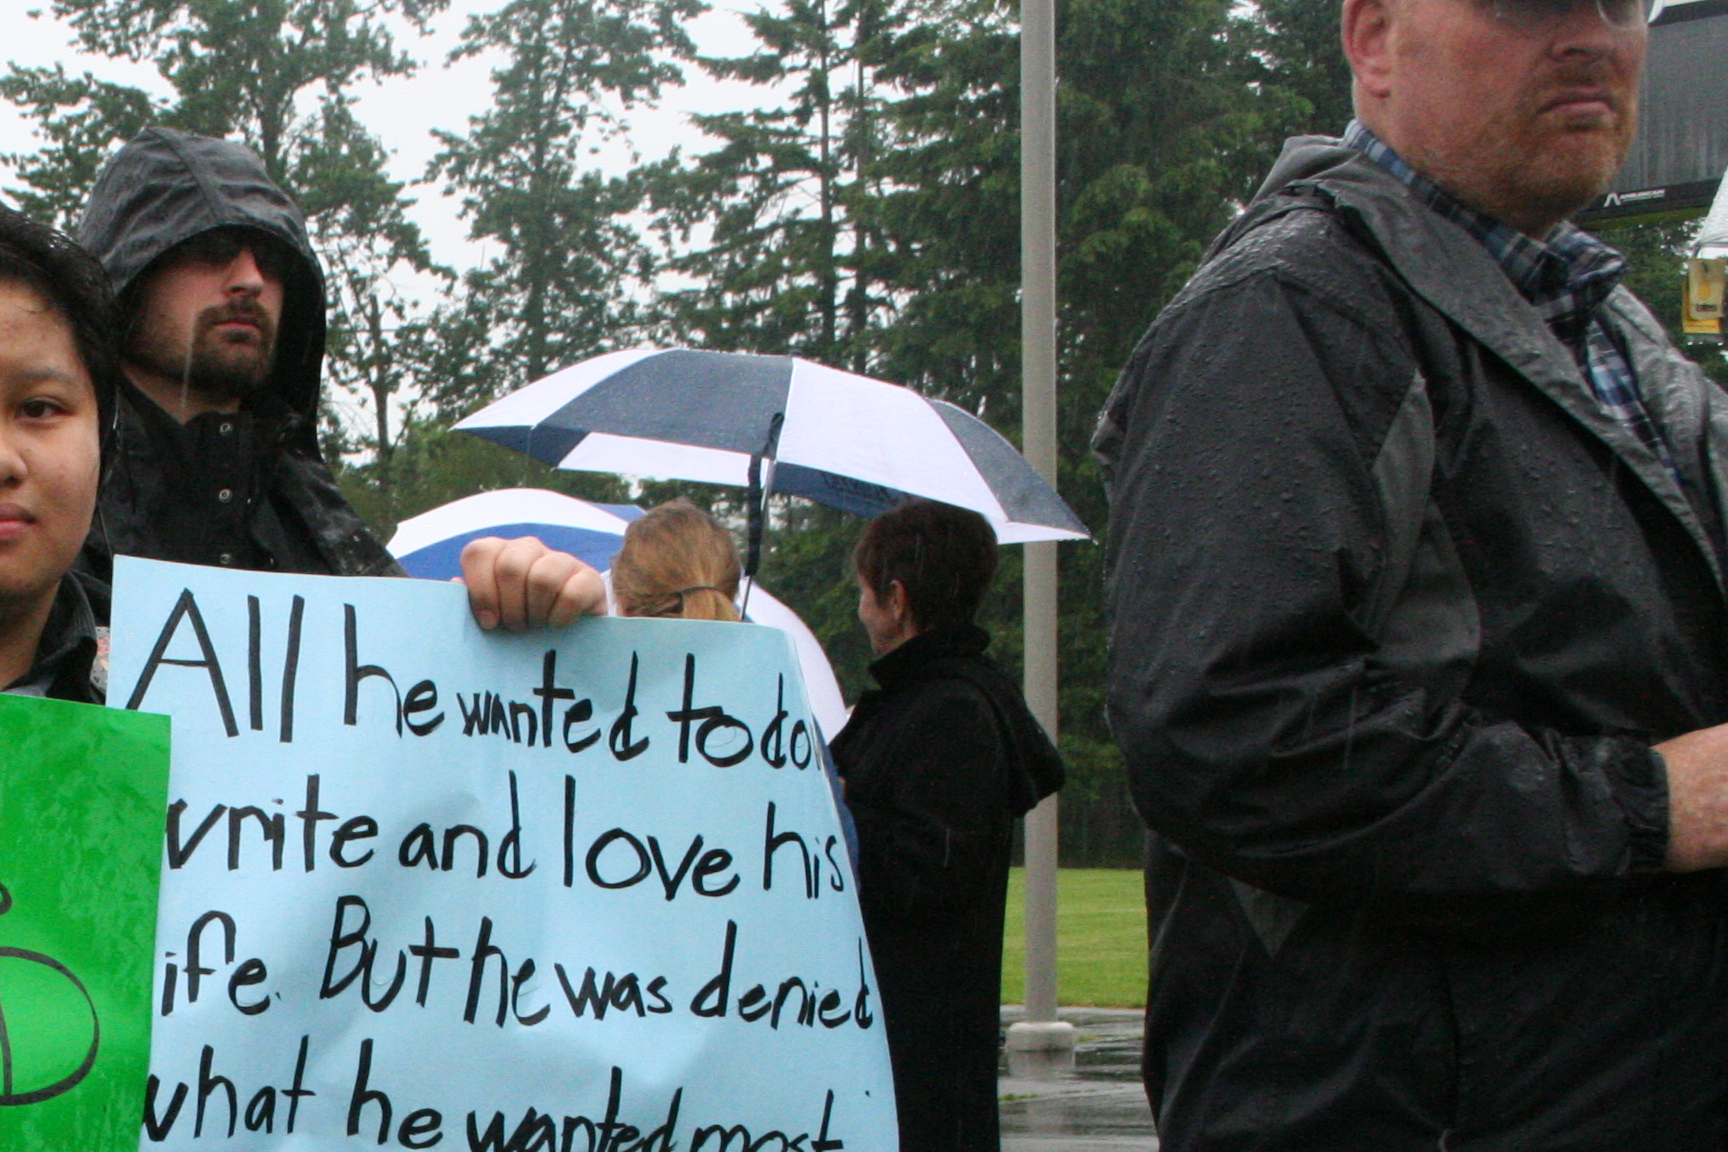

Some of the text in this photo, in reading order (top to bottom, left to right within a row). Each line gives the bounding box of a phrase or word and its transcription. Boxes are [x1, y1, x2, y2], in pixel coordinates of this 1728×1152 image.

[125, 588, 304, 743] All
[344, 603, 446, 739] he
[459, 649, 649, 762] wanted
[398, 769, 536, 880] and
[564, 774, 742, 902] love
[763, 801, 844, 900] his
[161, 894, 874, 1030] ife. But he was denied
[346, 1038, 443, 1151] he
